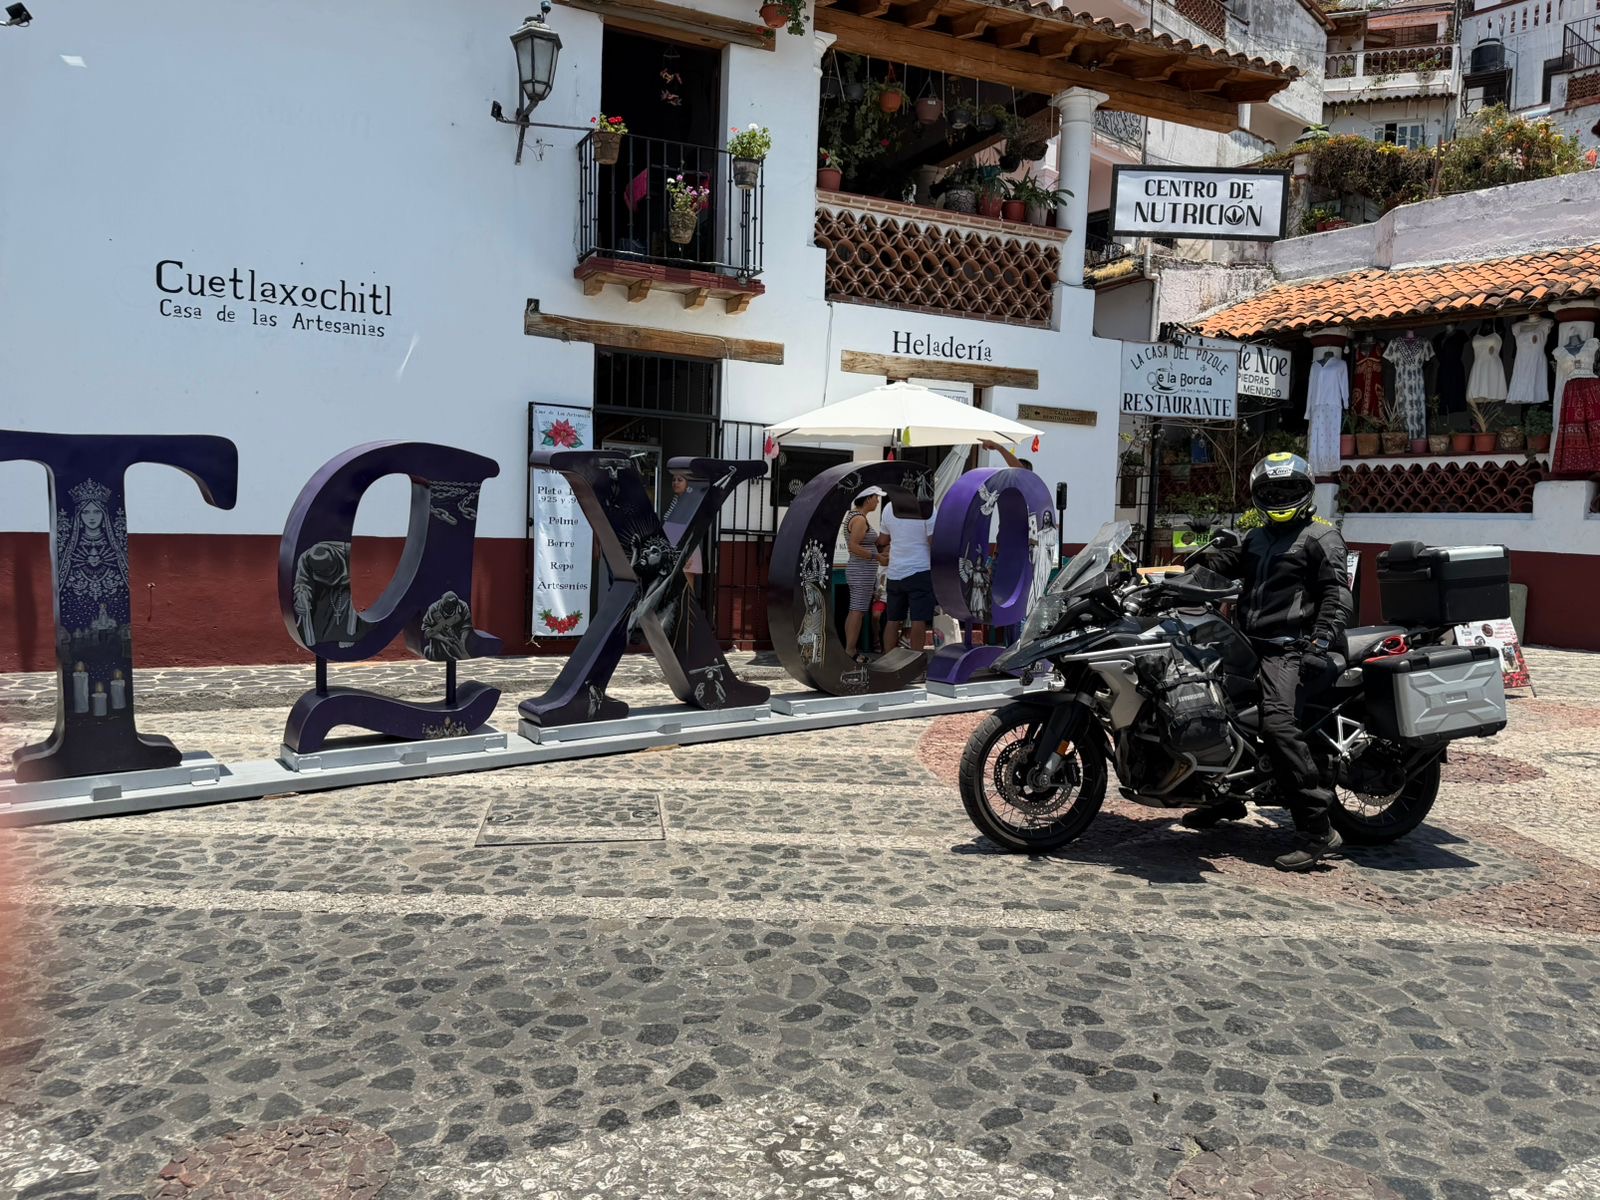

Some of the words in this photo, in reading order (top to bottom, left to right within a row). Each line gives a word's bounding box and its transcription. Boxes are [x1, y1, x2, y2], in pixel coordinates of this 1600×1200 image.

[1144, 179, 1218, 198] CENTRO
[1229, 181, 1254, 200] DE
[1134, 200, 1263, 227] NUTRICIÓN
[155, 259, 393, 317] Cuetlaxochitl
[159, 298, 202, 320] Casa
[216, 304, 236, 323] de
[252, 307, 278, 327] las
[892, 330, 993, 362] Heladería
[1130, 354, 1145, 371] LA
[1146, 345, 1169, 361] CASA
[1173, 346, 1190, 361] DEL
[1195, 348, 1230, 377] POZOLE
[1254, 346, 1288, 377] Noe
[1167, 372, 1177, 384] la
[1180, 373, 1213, 388] Borda
[1243, 384, 1282, 398] MENUDEO
[1123, 392, 1232, 417] RESTAURANTE
